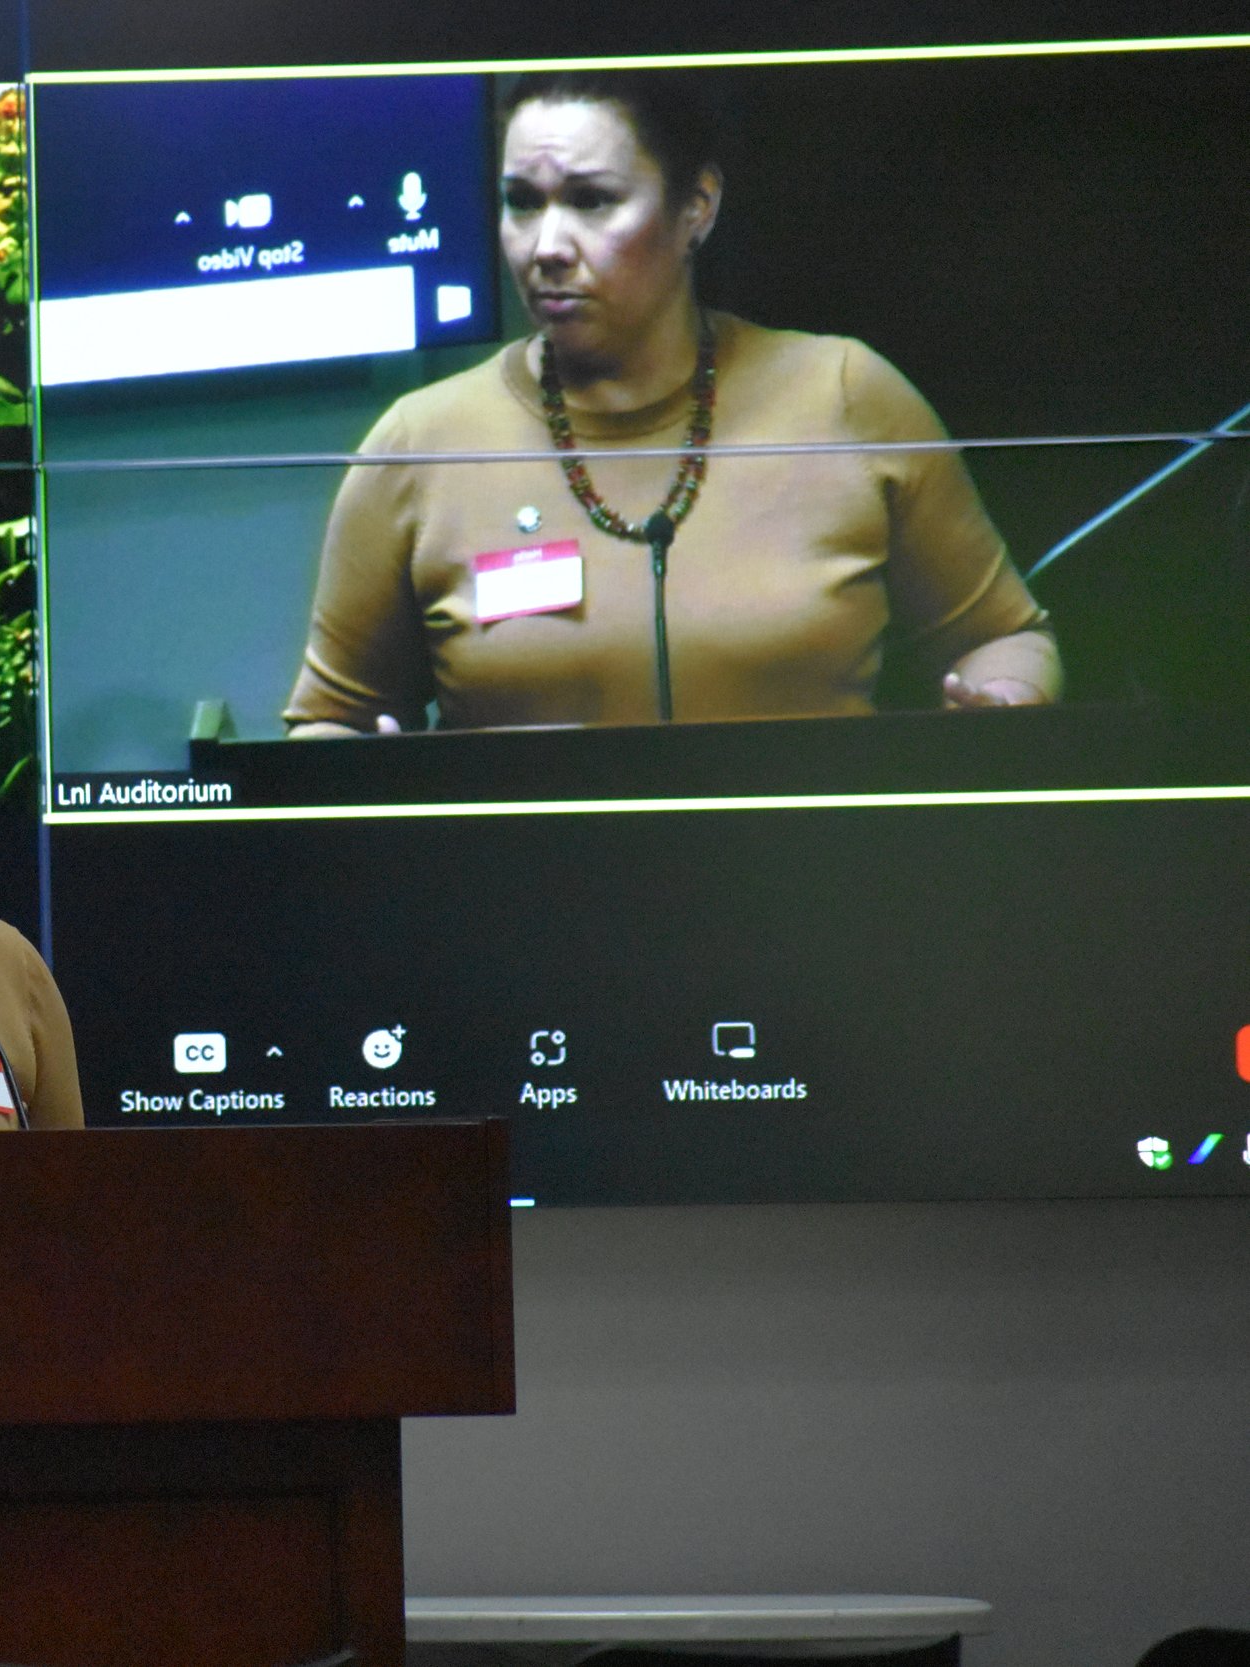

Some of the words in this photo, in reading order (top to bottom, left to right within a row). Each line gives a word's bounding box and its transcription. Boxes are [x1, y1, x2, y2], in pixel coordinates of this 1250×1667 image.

[98, 776, 233, 805] Auditorium
[120, 1089, 183, 1113] Show
[188, 1088, 286, 1116] Captions
[329, 1085, 437, 1109] Reactions
[519, 1081, 578, 1110] Apps
[662, 1077, 808, 1102] Whiteboards
